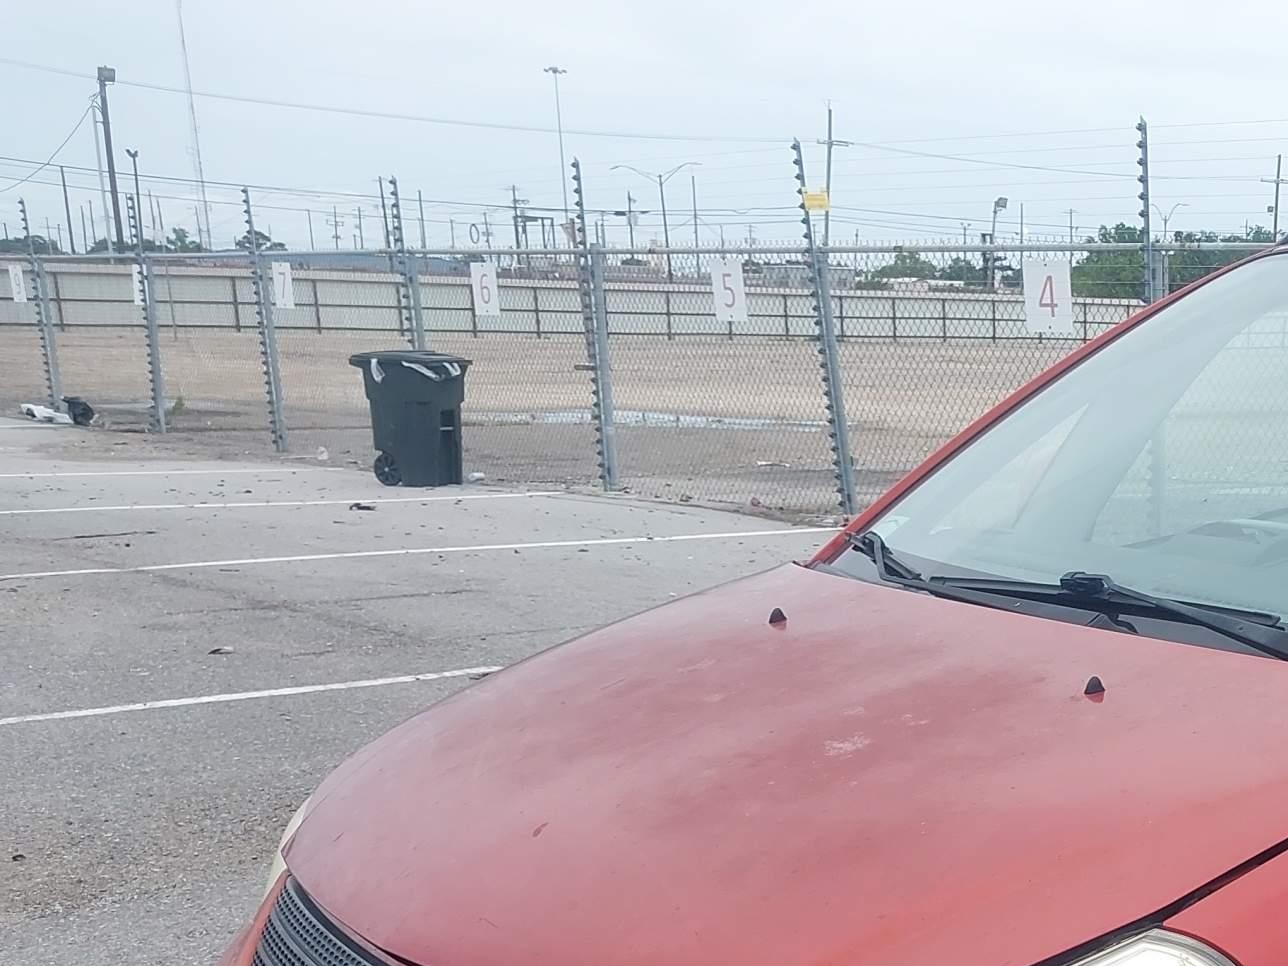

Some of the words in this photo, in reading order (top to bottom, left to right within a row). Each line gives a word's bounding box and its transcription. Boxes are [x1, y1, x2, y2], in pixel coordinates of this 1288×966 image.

[278, 271, 287, 300] 7
[479, 273, 492, 305] 6
[721, 272, 736, 309] 5
[1039, 275, 1058, 318] 4
